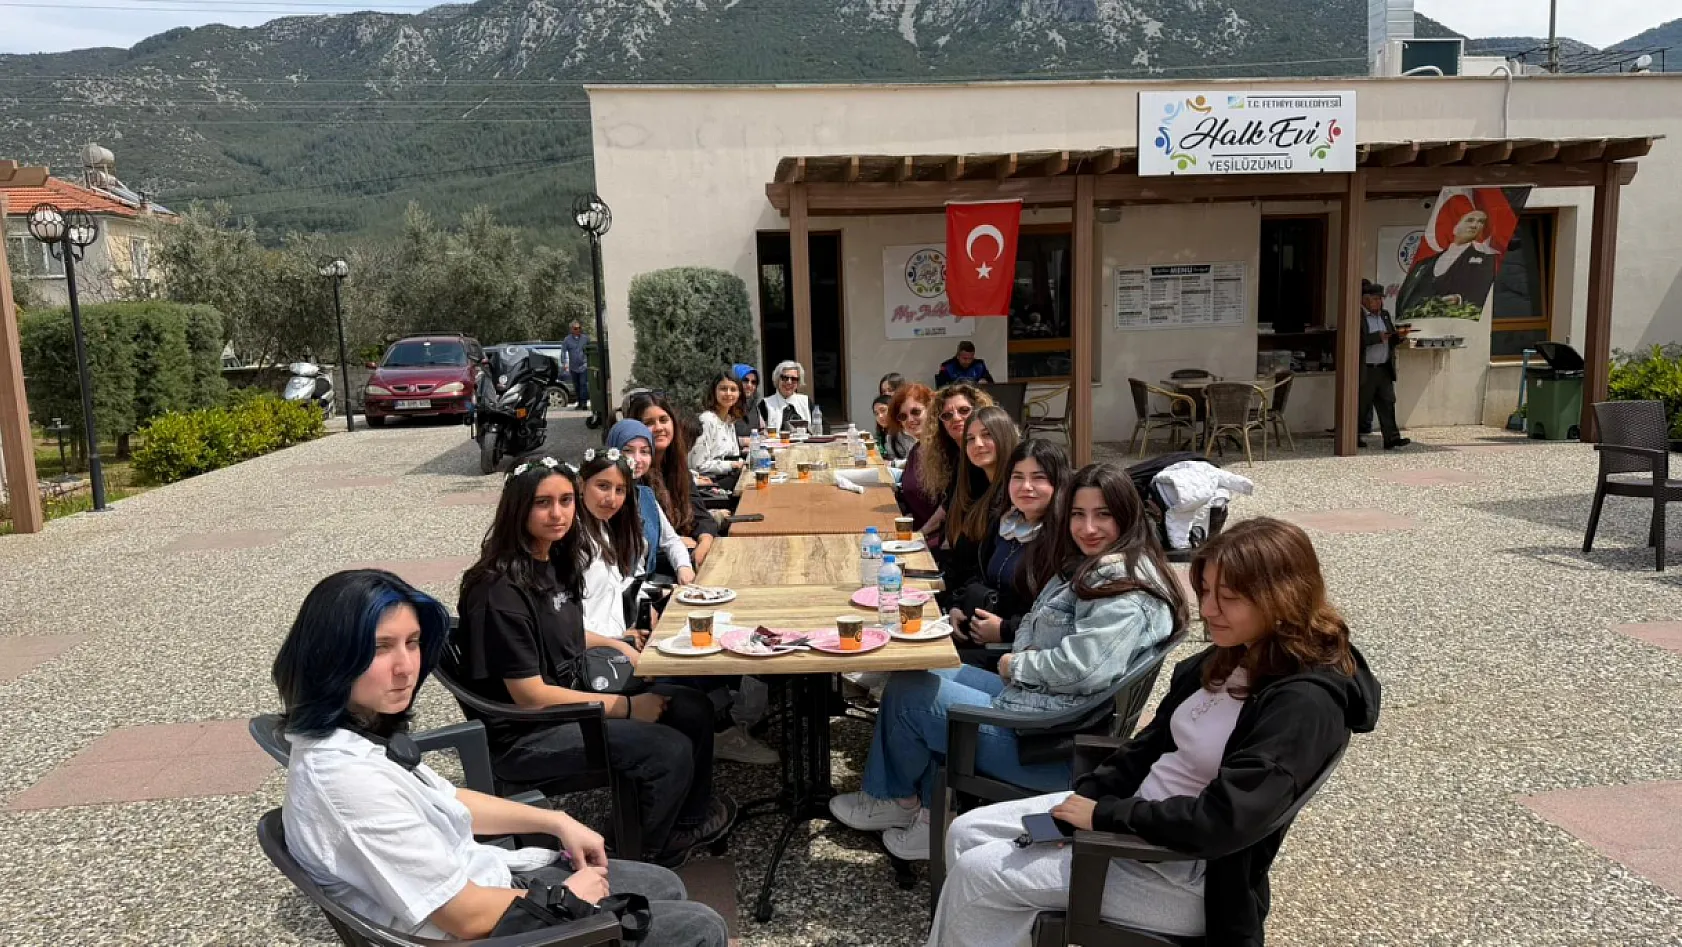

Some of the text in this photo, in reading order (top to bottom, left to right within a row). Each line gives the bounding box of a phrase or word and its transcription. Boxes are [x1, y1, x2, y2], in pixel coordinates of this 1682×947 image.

[1248, 100, 1260, 109] T.C.
[1262, 99, 1294, 109] FETHİYE
[1179, 115, 1320, 150] Halk Evi
[1208, 157, 1294, 172] YEŞİLÜZÜMLÜ
